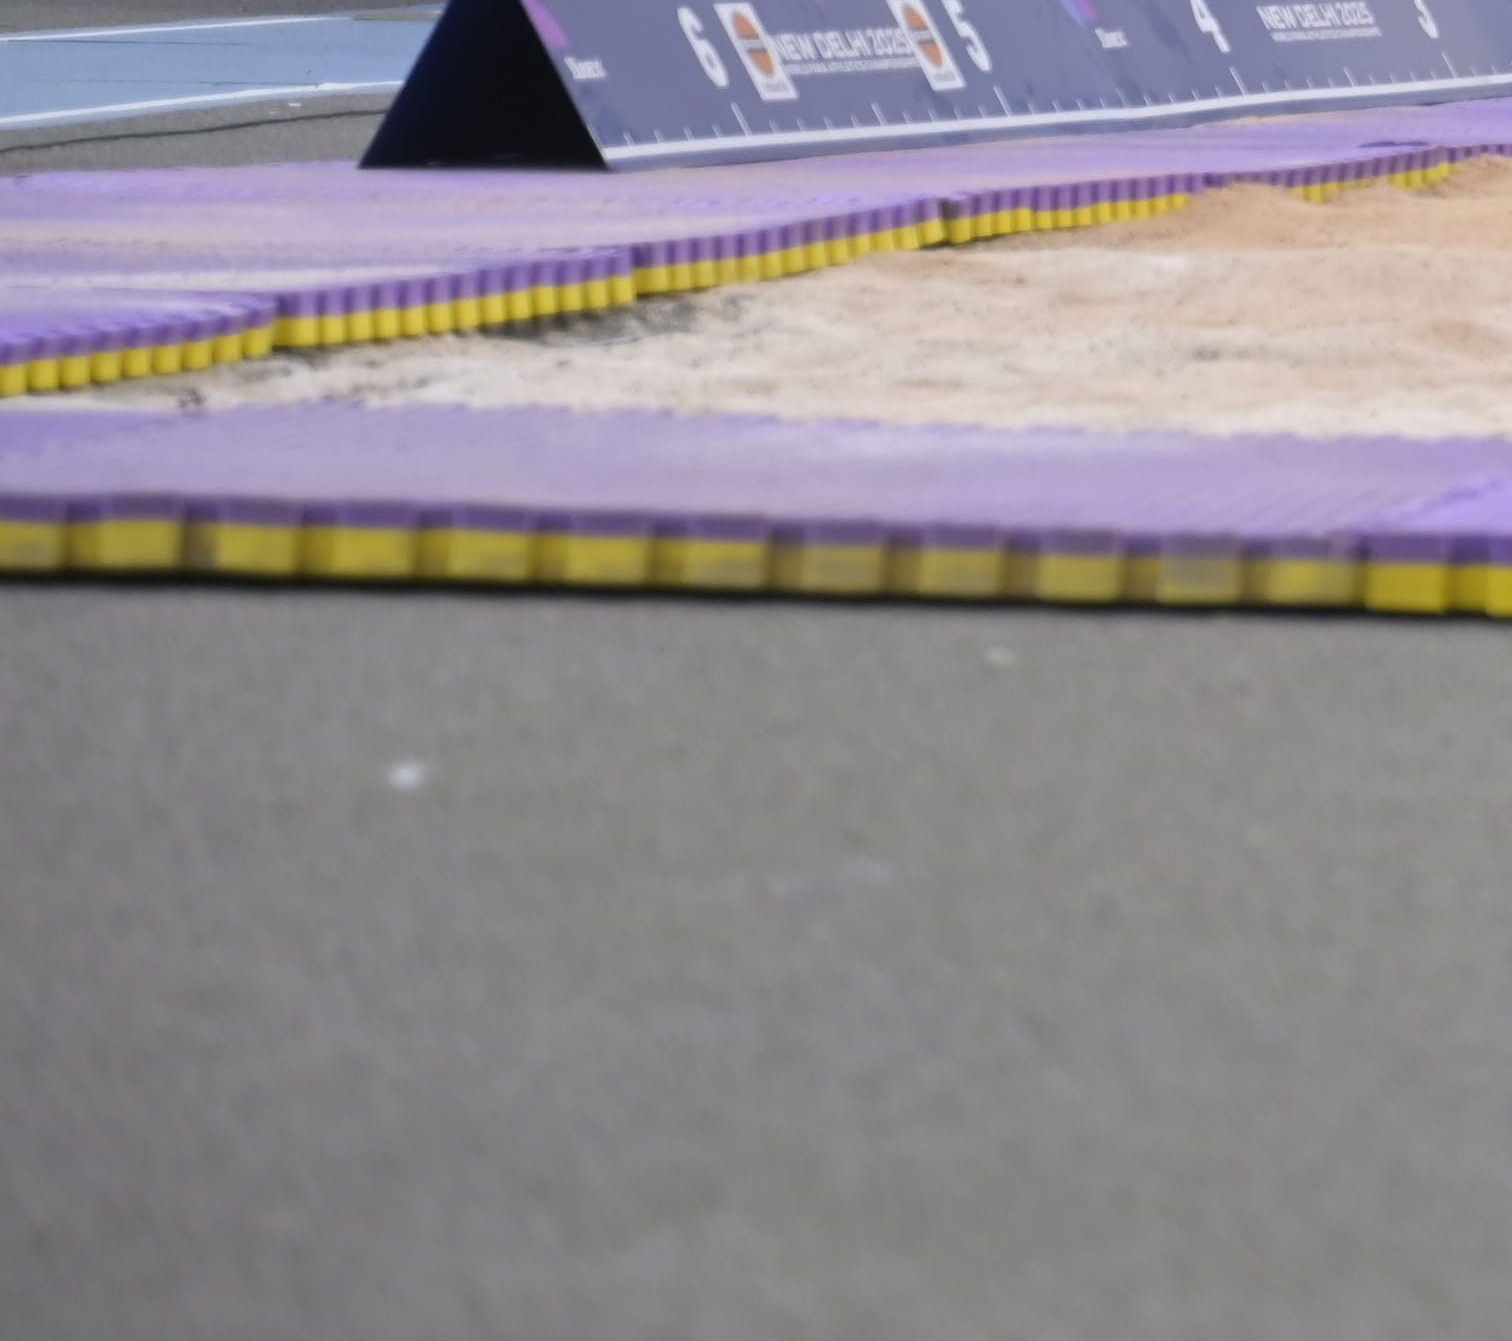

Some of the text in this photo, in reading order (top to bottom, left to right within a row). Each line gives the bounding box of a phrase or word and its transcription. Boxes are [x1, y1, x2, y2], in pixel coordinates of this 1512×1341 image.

[1256, 0, 1376, 30] NEW DELHI 2025
[677, 4, 730, 89] 6
[769, 32, 818, 63] NEW
[811, 29, 868, 60] DELHI
